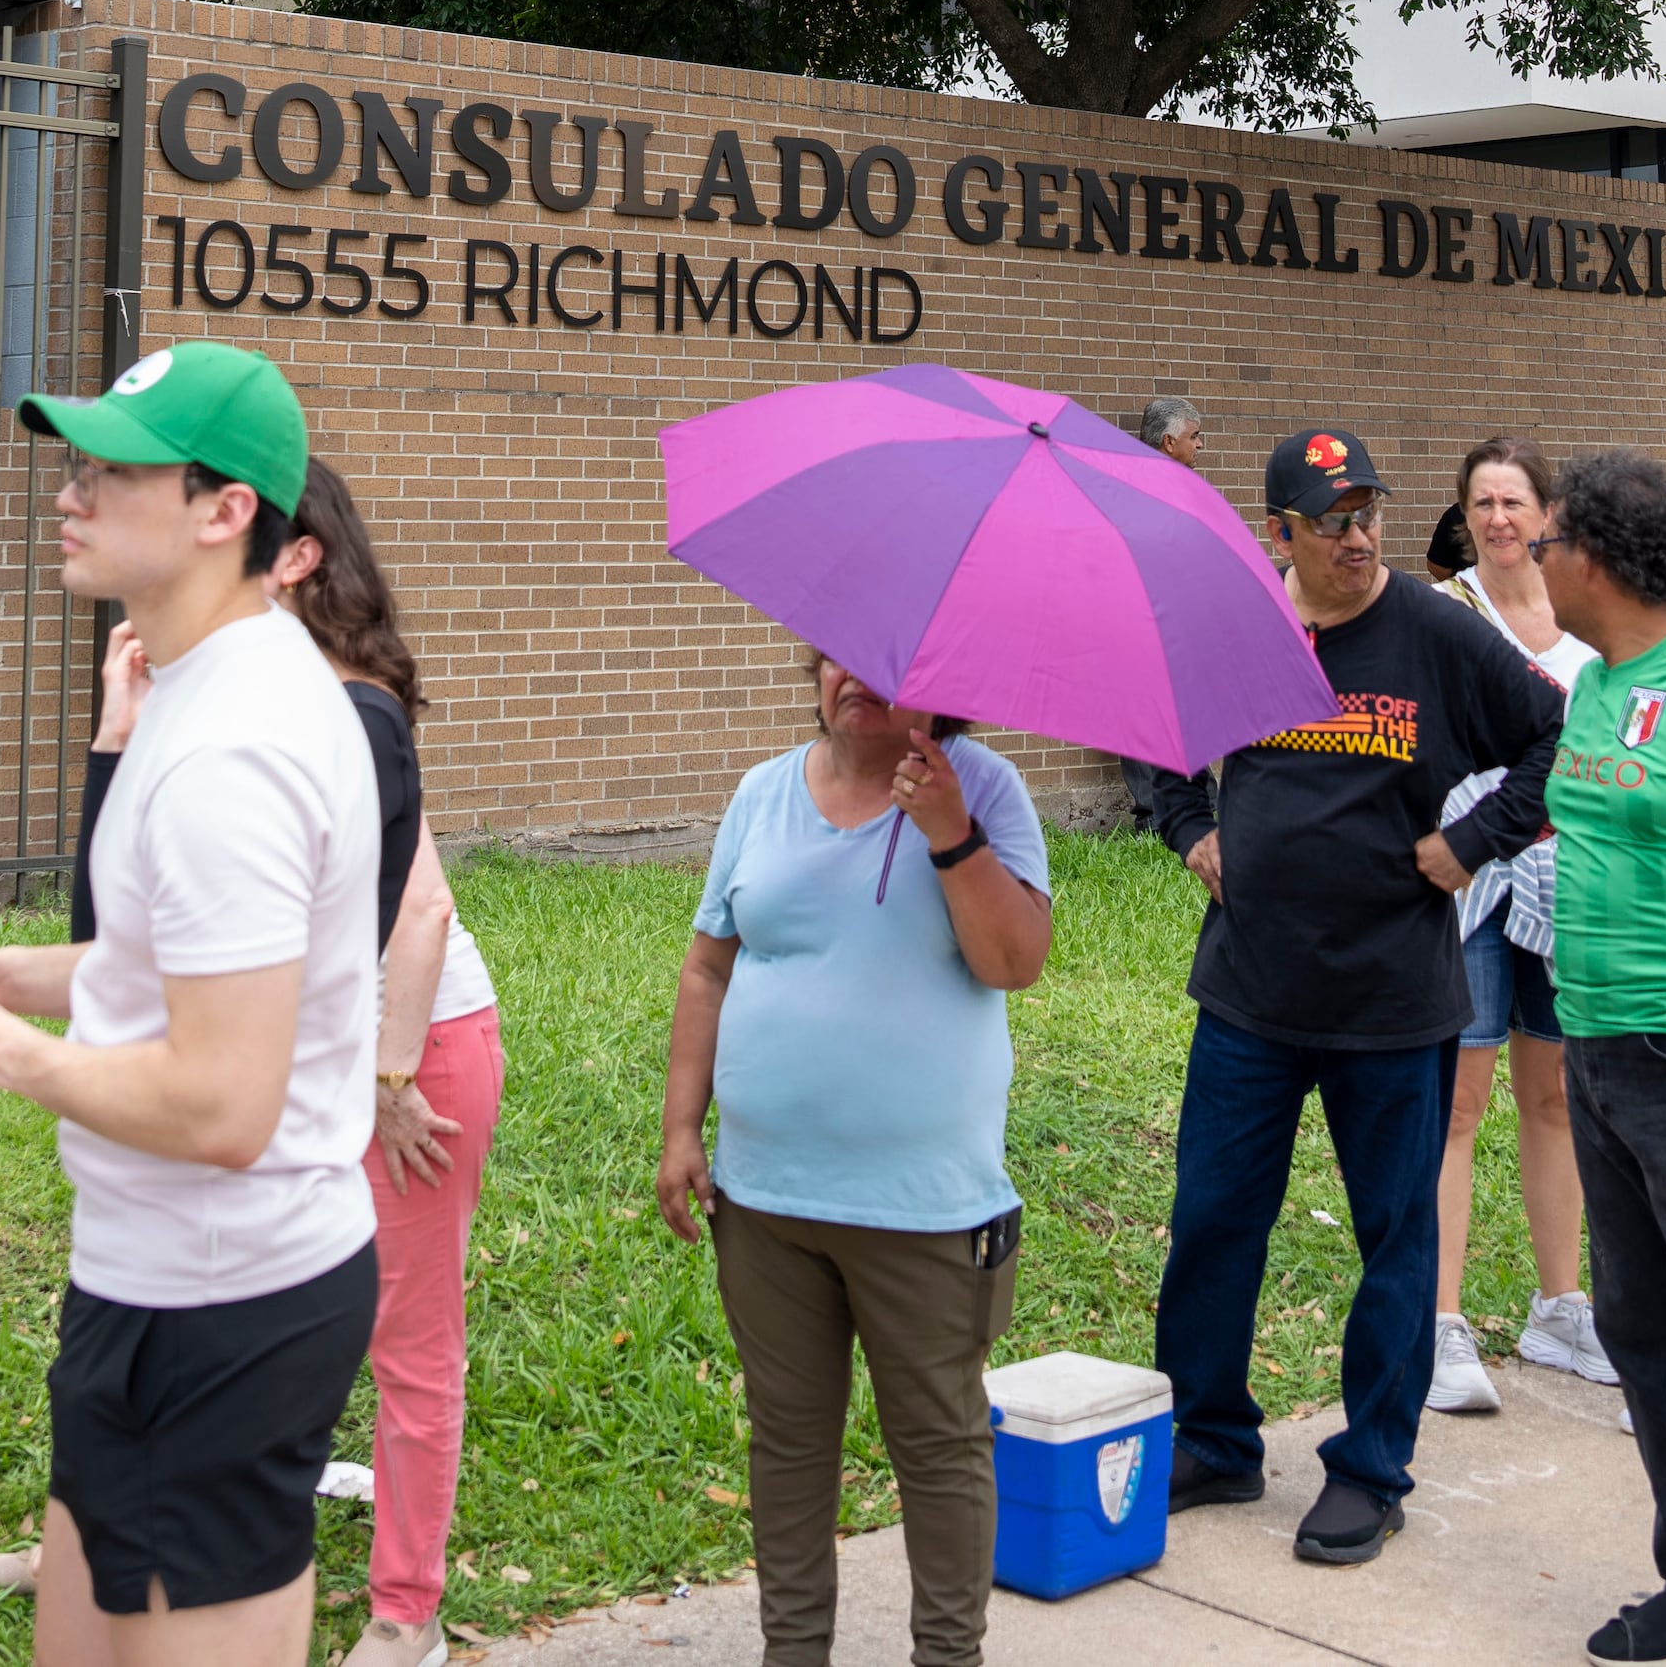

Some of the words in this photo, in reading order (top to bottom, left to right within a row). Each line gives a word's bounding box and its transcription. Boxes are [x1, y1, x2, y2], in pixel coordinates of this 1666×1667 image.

[160, 72, 916, 237] CONSULADO
[945, 154, 1359, 274] GENERAL
[1378, 199, 1474, 282] DE
[158, 215, 430, 319] 10555
[466, 238, 922, 342] RICHMOND
[1324, 464, 1348, 477] JAPAN
[1374, 715, 1418, 742] THE
[1553, 748, 1647, 790] EXICO
